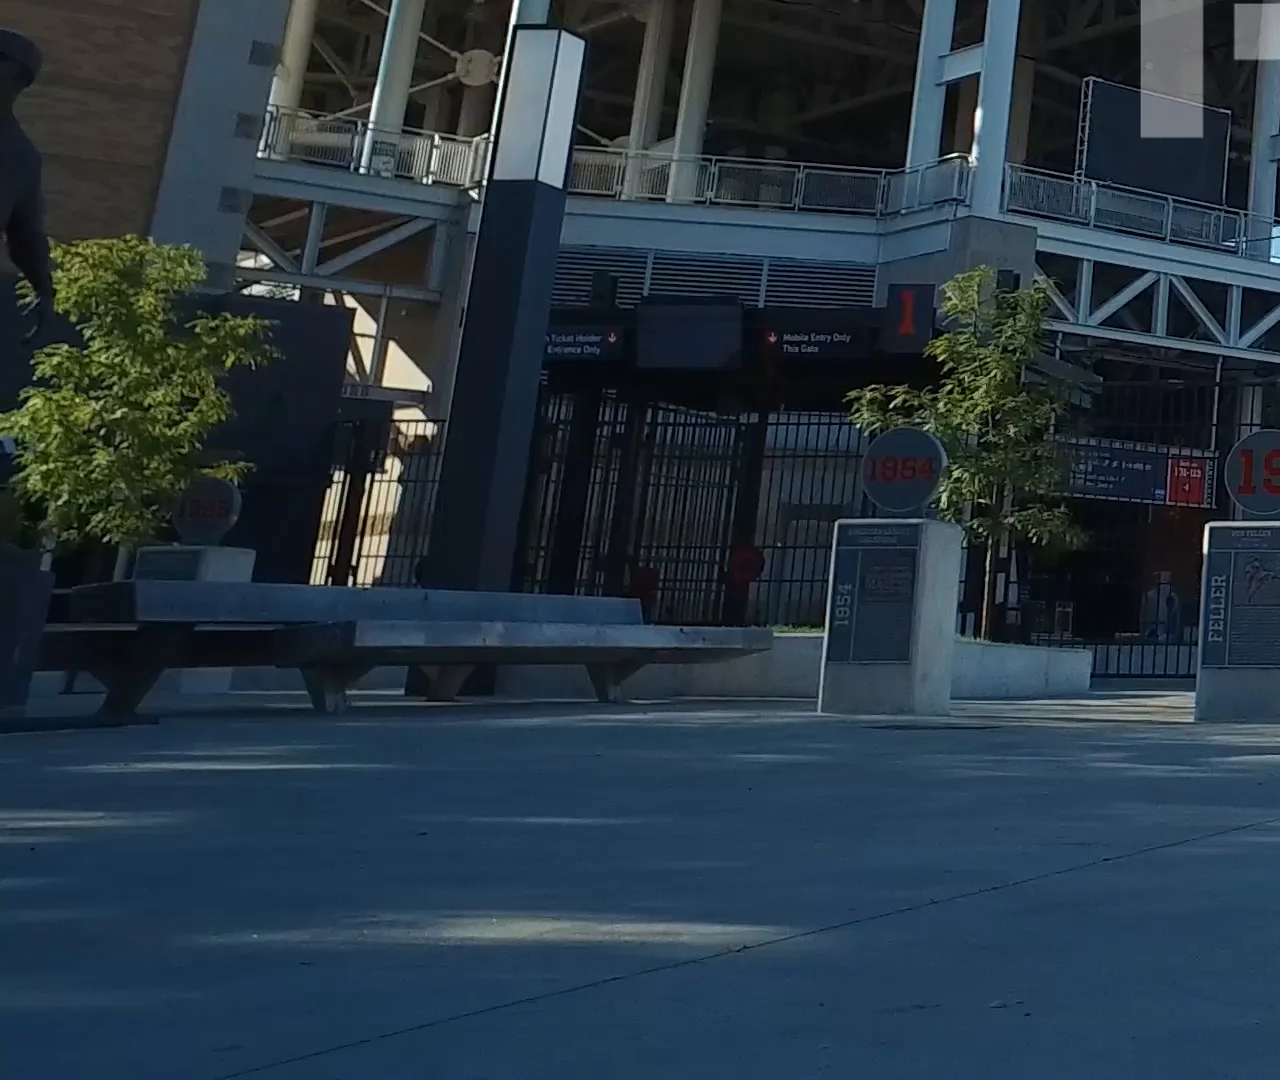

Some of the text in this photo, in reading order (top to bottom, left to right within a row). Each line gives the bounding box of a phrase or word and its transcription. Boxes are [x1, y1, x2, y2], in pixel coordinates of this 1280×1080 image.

[898, 291, 915, 335] 1
[583, 345, 600, 355] Only
[783, 333, 851, 343] Mobile Entry Only
[783, 344, 818, 353] This Gate
[868, 457, 935, 483] 1954
[834, 583, 851, 626] 1954
[1208, 575, 1227, 643] FELLER
